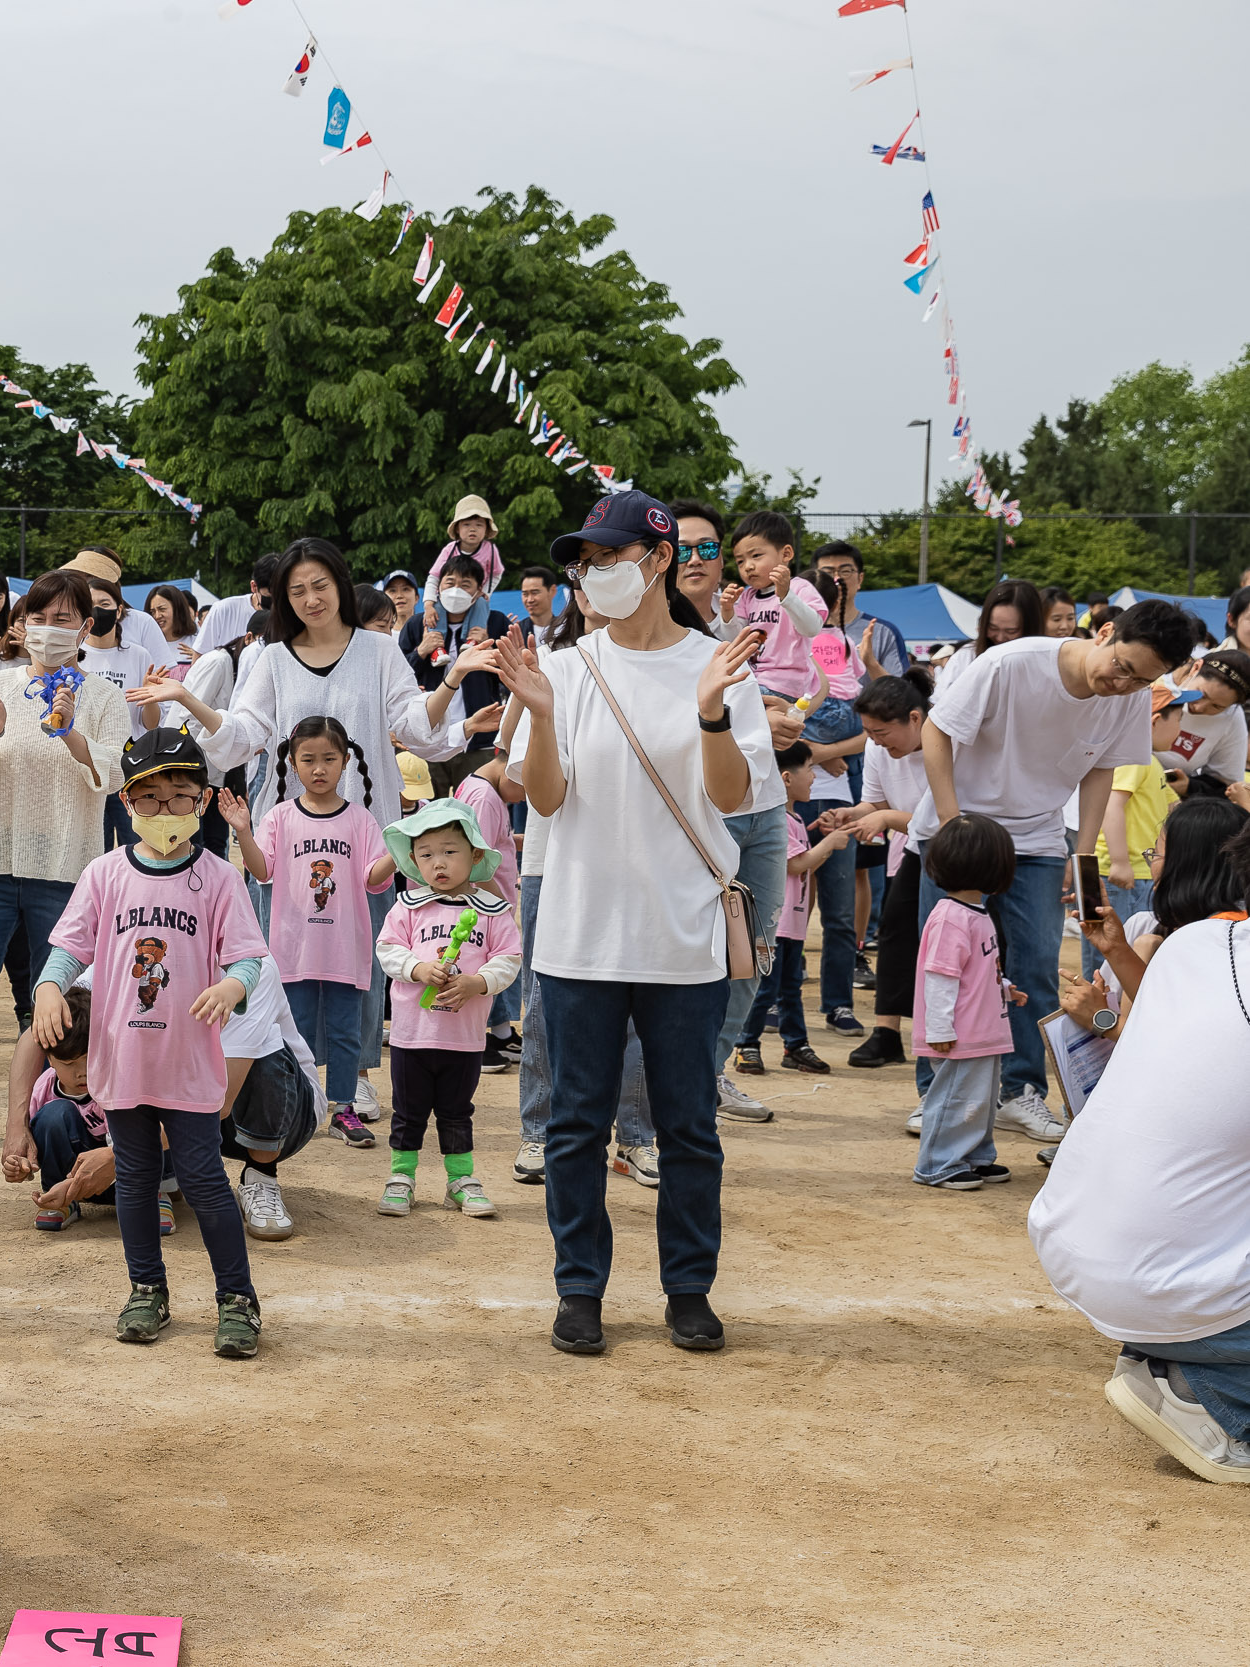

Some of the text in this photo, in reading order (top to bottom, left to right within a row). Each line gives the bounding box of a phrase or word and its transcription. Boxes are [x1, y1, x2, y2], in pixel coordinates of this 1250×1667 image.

[293, 838, 352, 860] L.BLANCS
[115, 906, 198, 937] L.BLANCS
[420, 924, 485, 947] L.BLCS
